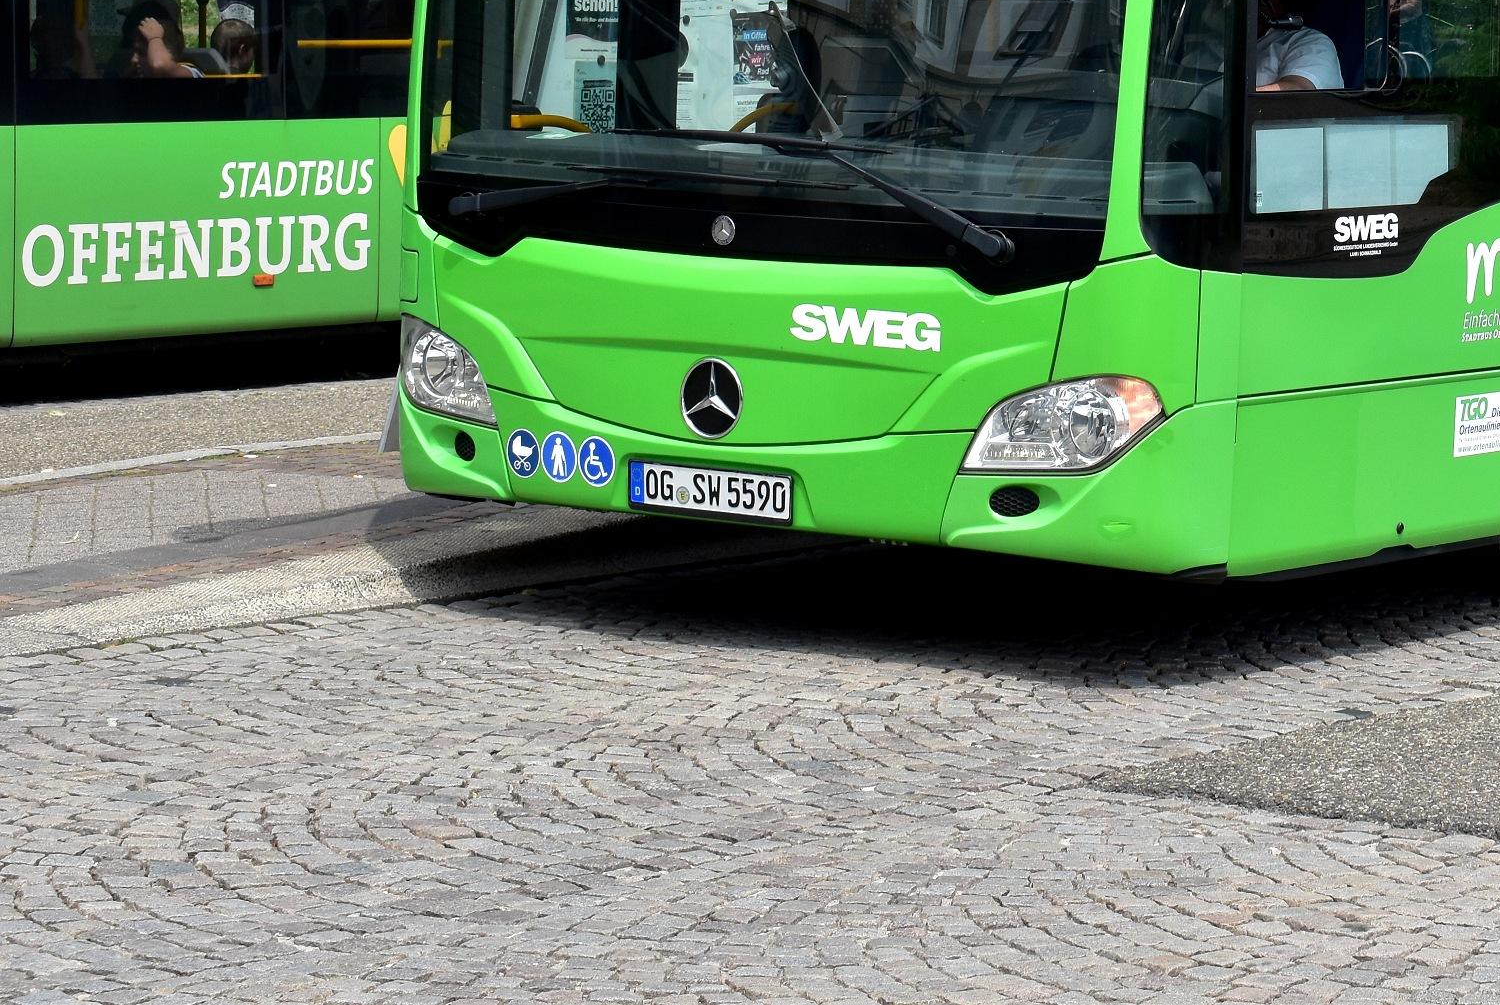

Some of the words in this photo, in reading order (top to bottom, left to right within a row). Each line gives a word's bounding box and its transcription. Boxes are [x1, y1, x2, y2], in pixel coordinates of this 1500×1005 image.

[219, 158, 374, 201] STADTBUS
[1333, 212, 1399, 243] SWEG
[22, 212, 371, 288] OFFENBURG
[789, 303, 942, 352] SWEG
[1459, 420, 1500, 436] Ortenaulinie
[1460, 396, 1489, 422] TGO
[645, 469, 674, 501] OG
[692, 473, 721, 507] SW
[727, 477, 786, 513] 5590
